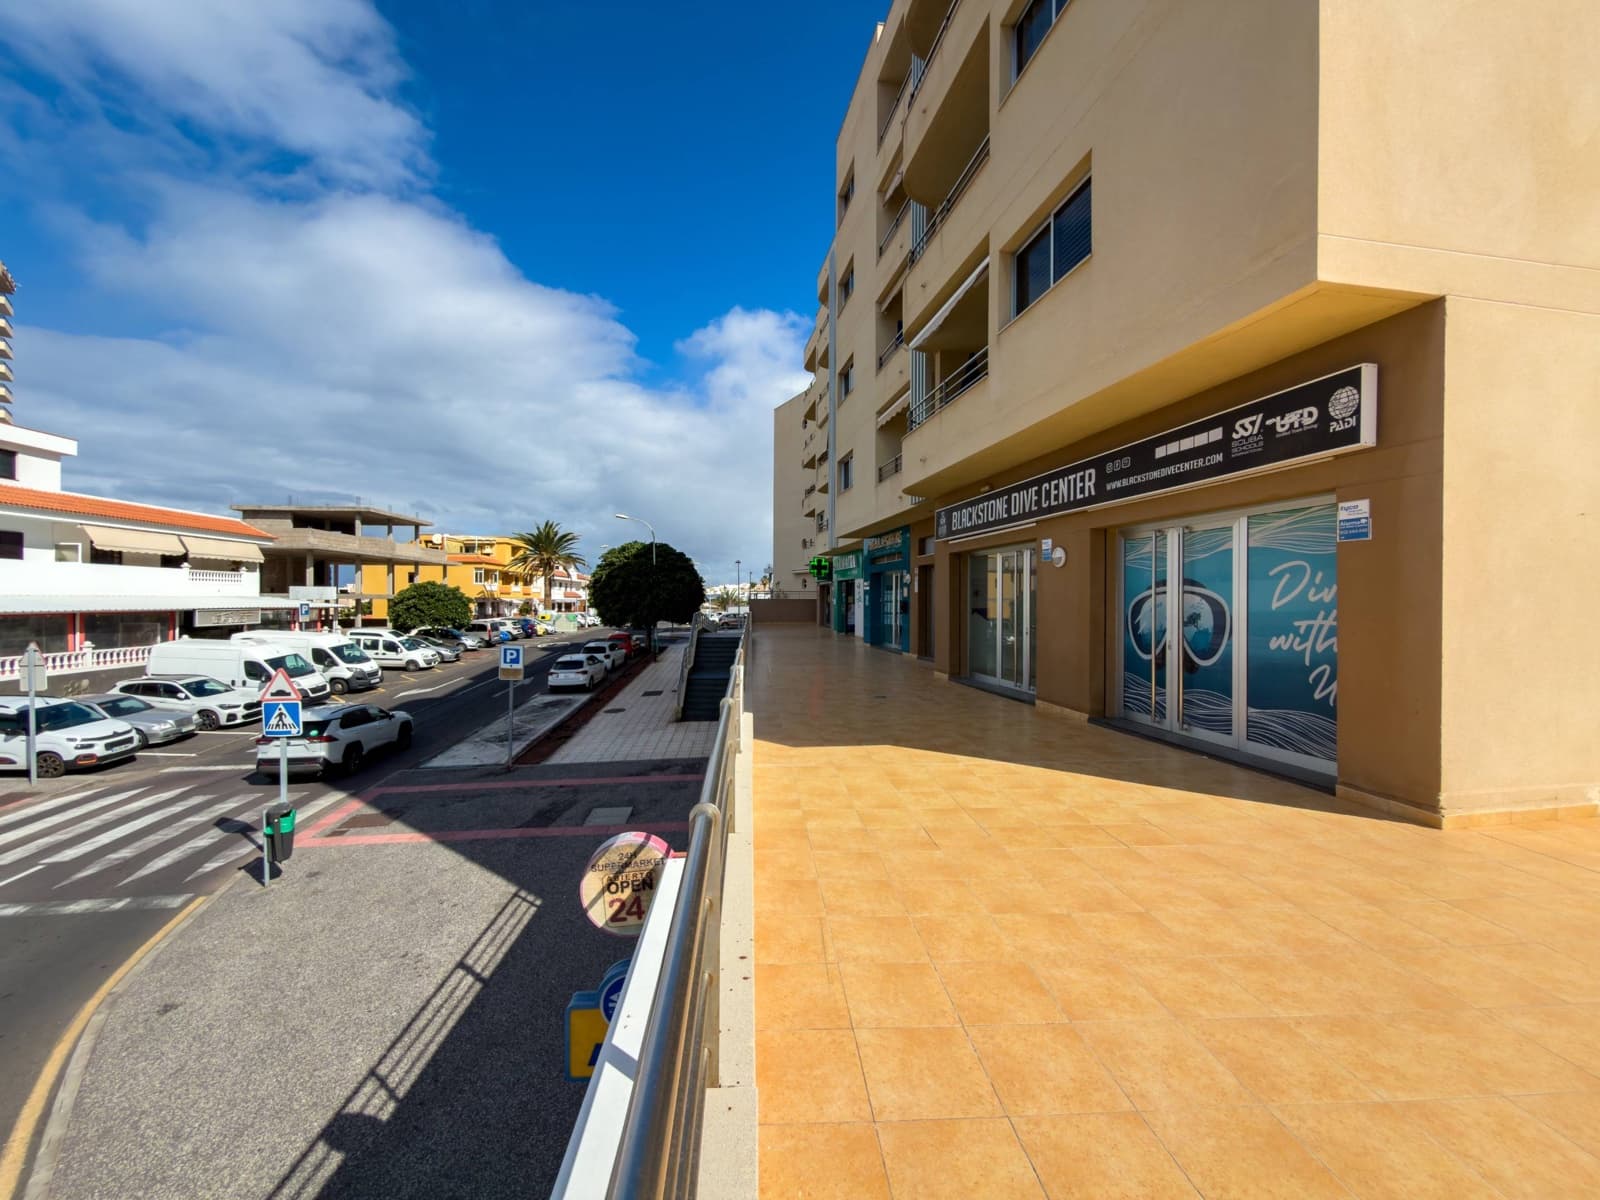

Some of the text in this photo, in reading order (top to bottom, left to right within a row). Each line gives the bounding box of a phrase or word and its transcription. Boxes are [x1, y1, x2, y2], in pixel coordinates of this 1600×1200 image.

[1329, 415, 1357, 433] PADI
[1232, 434, 1264, 448] SCUBA
[1106, 452, 1224, 491] WWW.BLACKSTONEDIVECENTER.COM
[951, 468, 1096, 531] BLACKSTONE DIVE CENTER
[302, 605, 309, 614] P
[506, 650, 517, 662] P
[591, 857, 667, 872] SUPERMARKET
[607, 877, 653, 894] OPEN
[609, 896, 646, 923] 24
